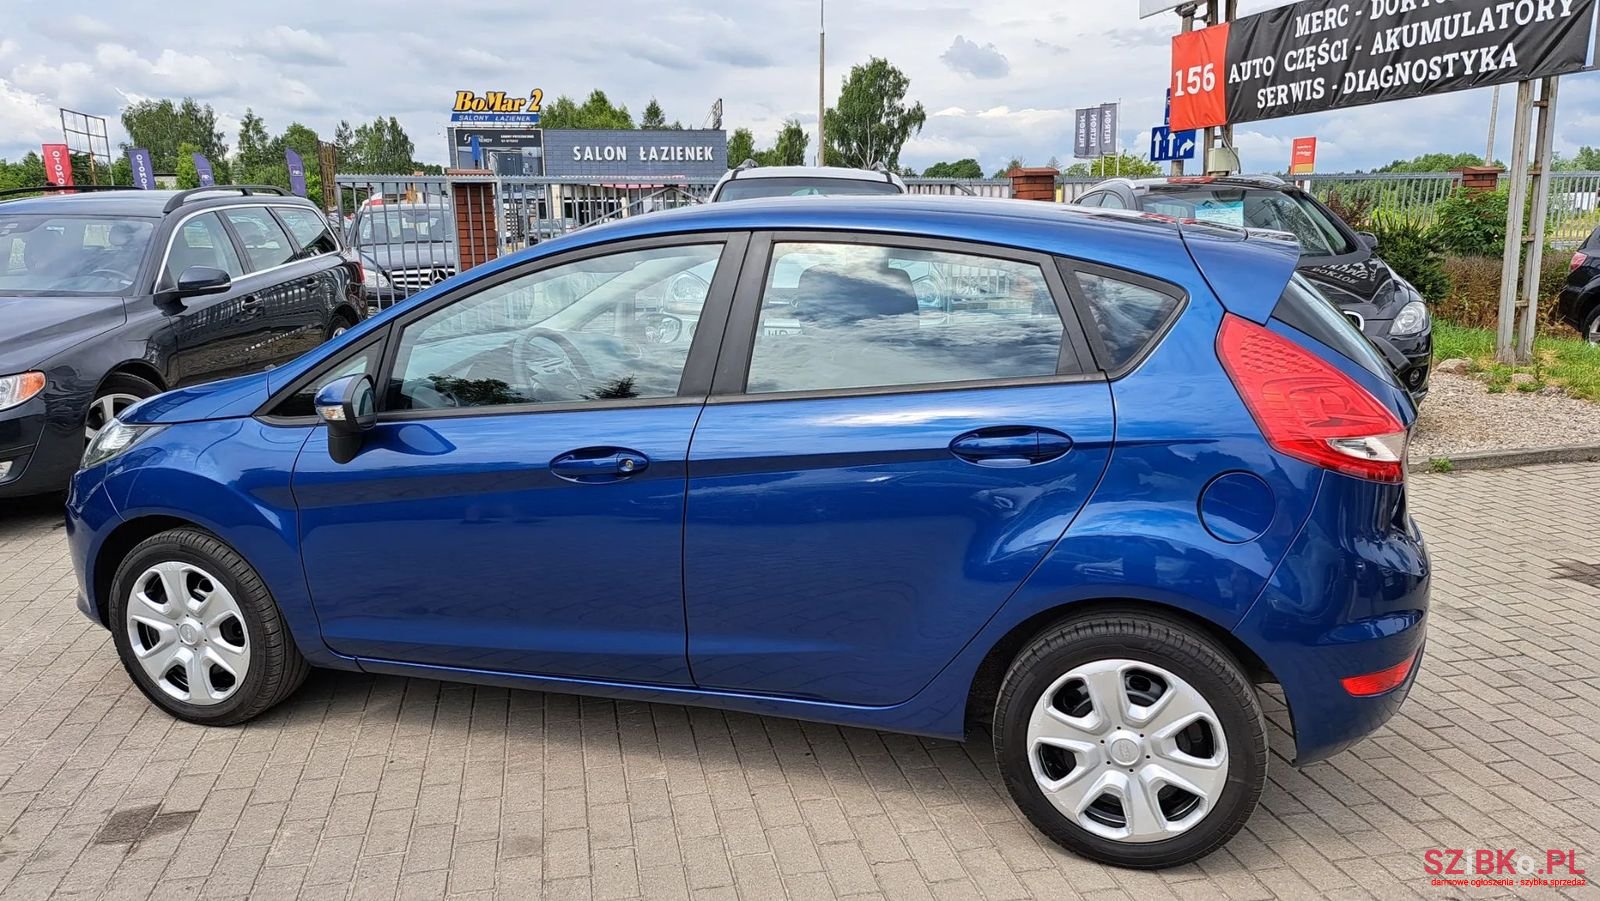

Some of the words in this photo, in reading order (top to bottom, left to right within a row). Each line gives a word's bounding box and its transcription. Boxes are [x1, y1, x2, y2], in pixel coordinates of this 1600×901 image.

[1294, 4, 1350, 38] MERC
[1228, 55, 1276, 84] AUTO
[1283, 38, 1349, 73] CZĘŚCI
[1369, 0, 1573, 55] AKUMULATORY
[1174, 63, 1216, 97] 156
[1256, 77, 1325, 109] SERWIS
[1342, 42, 1518, 94] DIAGNOSTYKA
[452, 91, 527, 112] BoMar
[526, 88, 543, 112] 2
[573, 146, 627, 161] SALON
[639, 146, 714, 161] ŁAZIENEK
